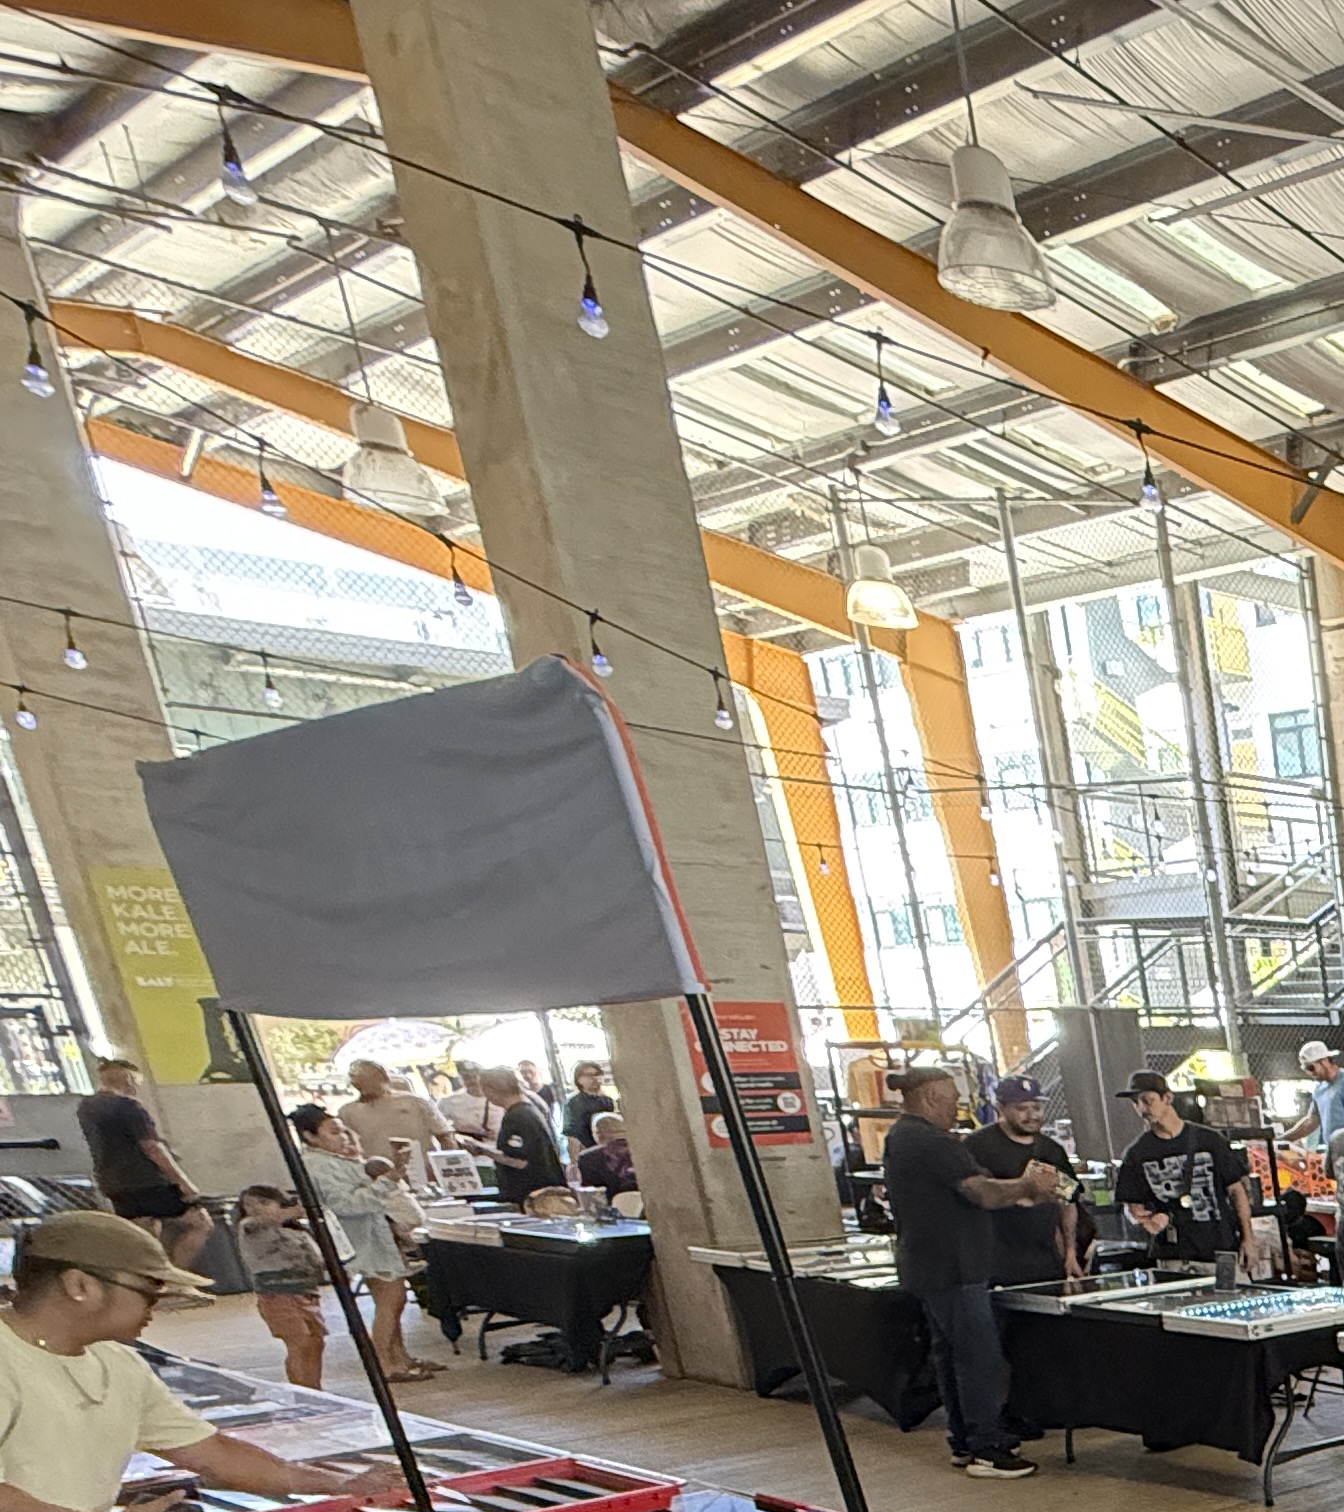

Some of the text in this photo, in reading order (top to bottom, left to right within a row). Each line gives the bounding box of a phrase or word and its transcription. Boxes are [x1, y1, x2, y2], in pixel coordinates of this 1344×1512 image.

[105, 884, 182, 903] MORE
[116, 921, 193, 939] MORE
[719, 1028, 758, 1040] STAY
